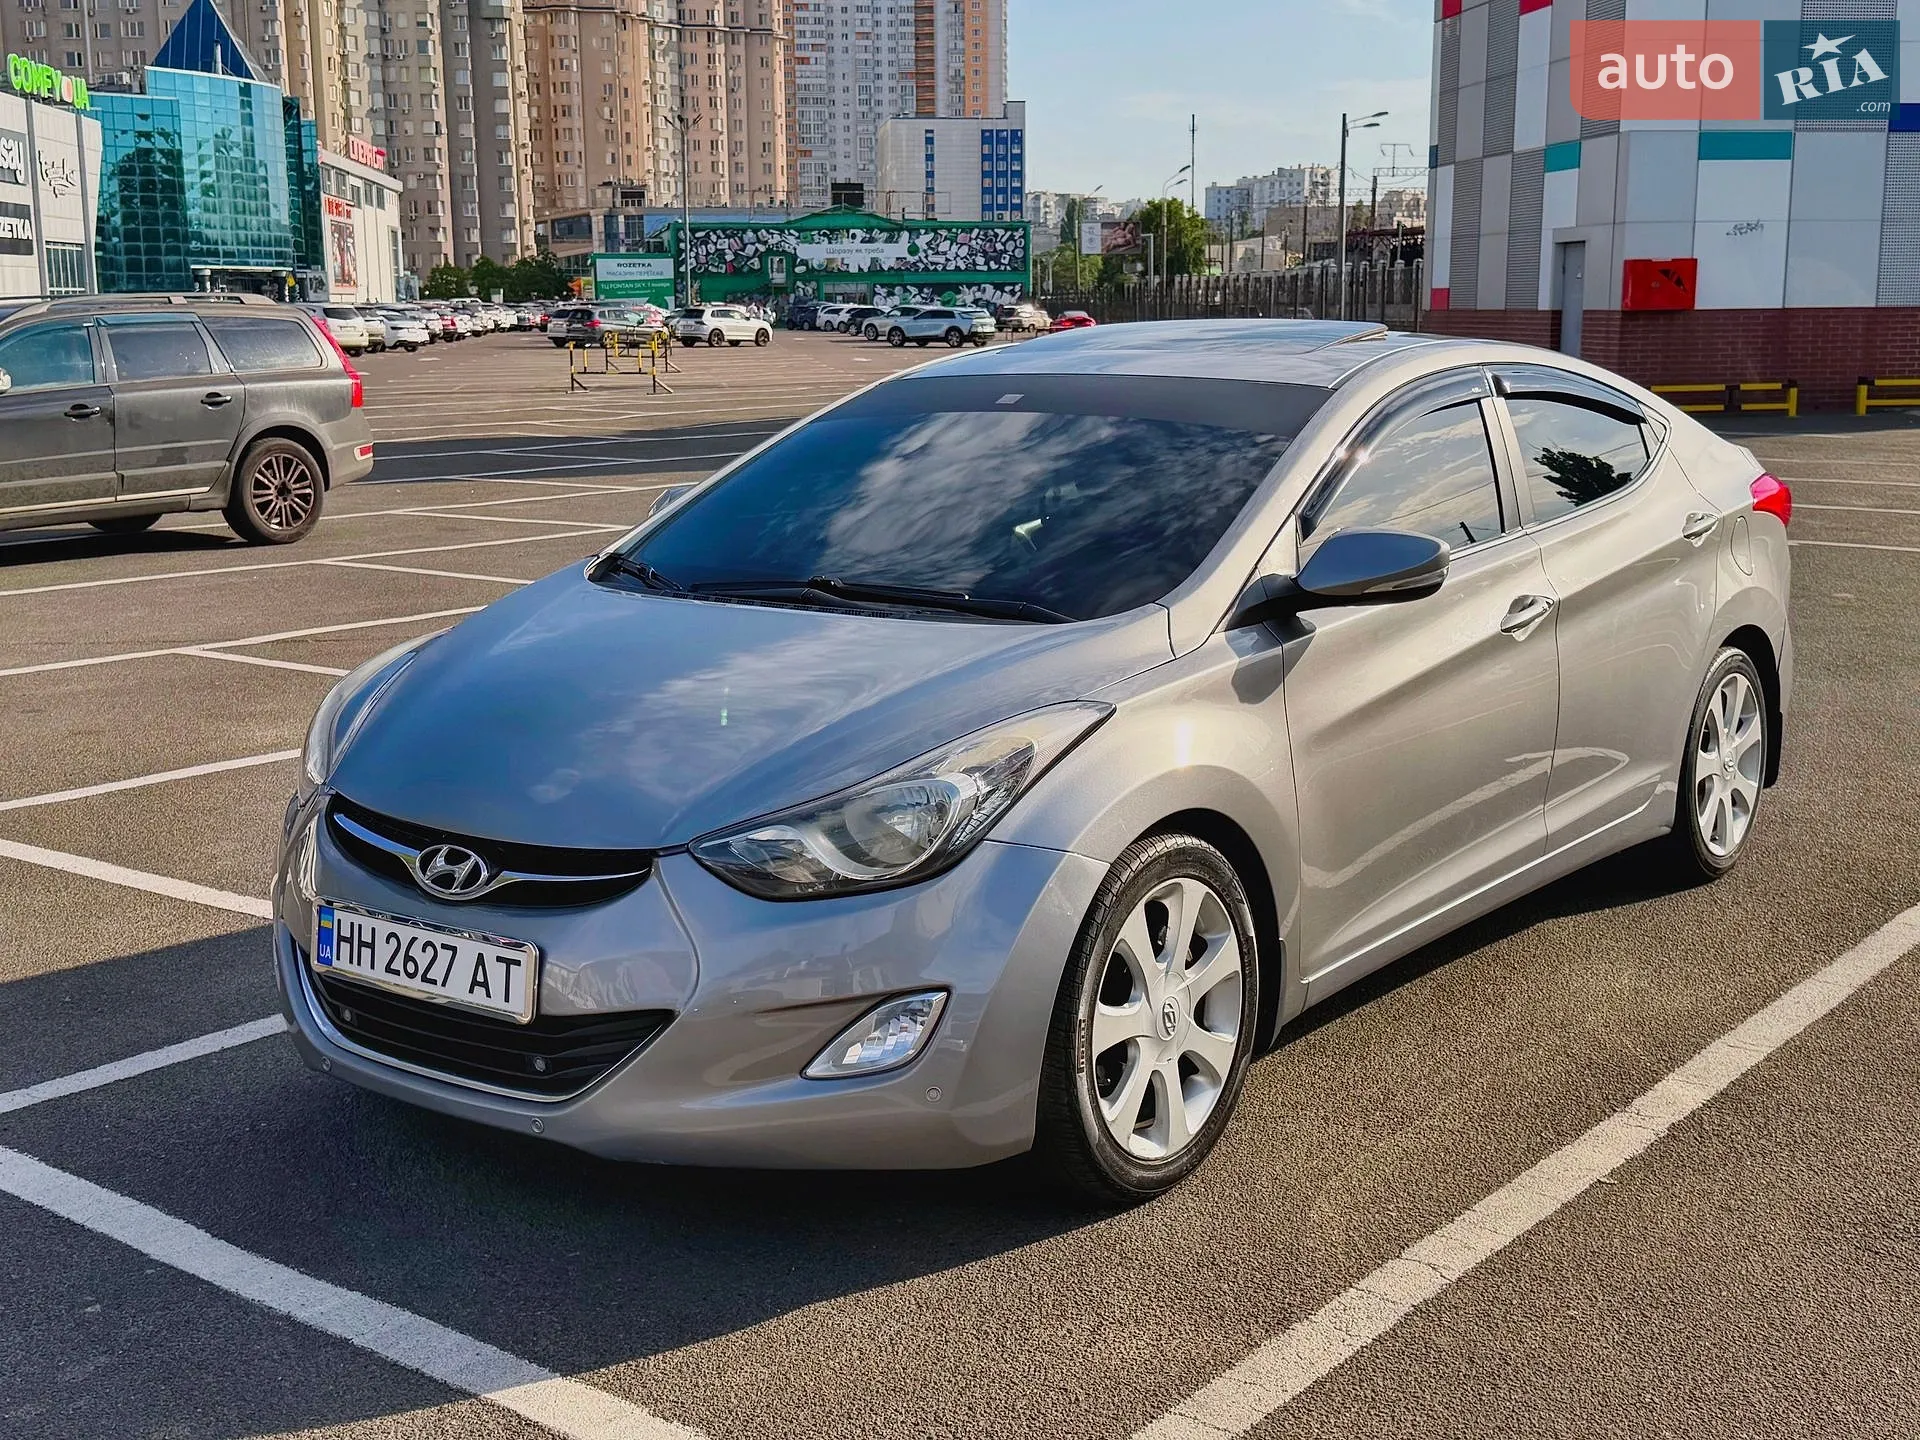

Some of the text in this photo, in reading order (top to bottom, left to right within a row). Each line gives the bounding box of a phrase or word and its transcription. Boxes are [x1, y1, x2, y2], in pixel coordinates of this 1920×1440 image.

[319, 944, 332, 959] UA
[336, 918, 522, 1003] HH 2627 AT
